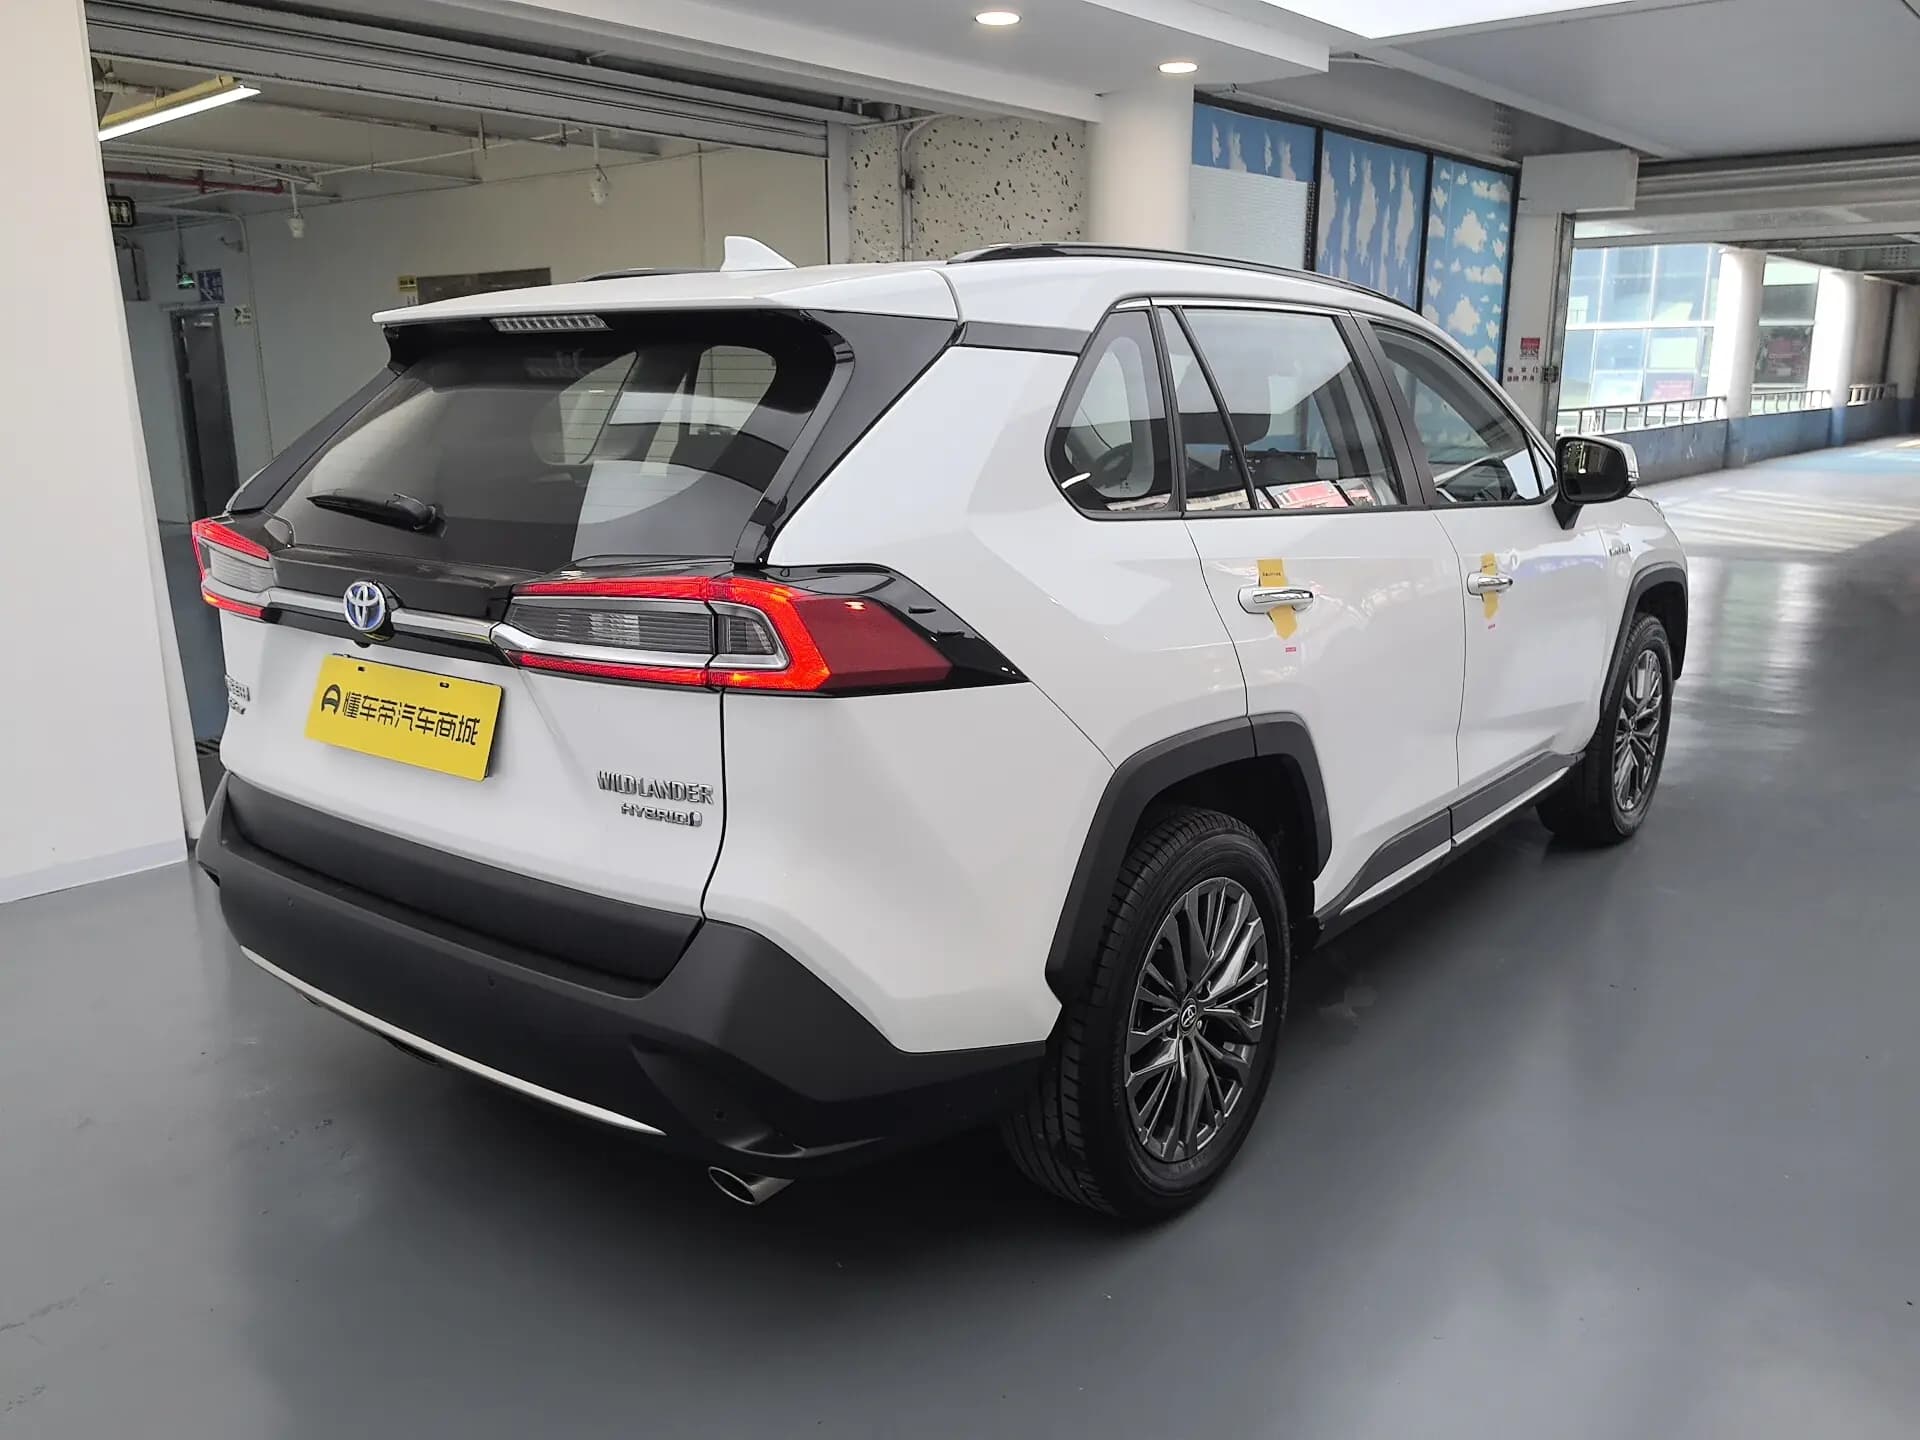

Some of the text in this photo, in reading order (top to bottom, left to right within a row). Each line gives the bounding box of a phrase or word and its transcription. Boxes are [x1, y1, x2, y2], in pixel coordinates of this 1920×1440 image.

[343, 691, 481, 745] 懂车帝汽车商城
[597, 770, 714, 805] WILDLANDER
[621, 802, 689, 826] HYBRID
